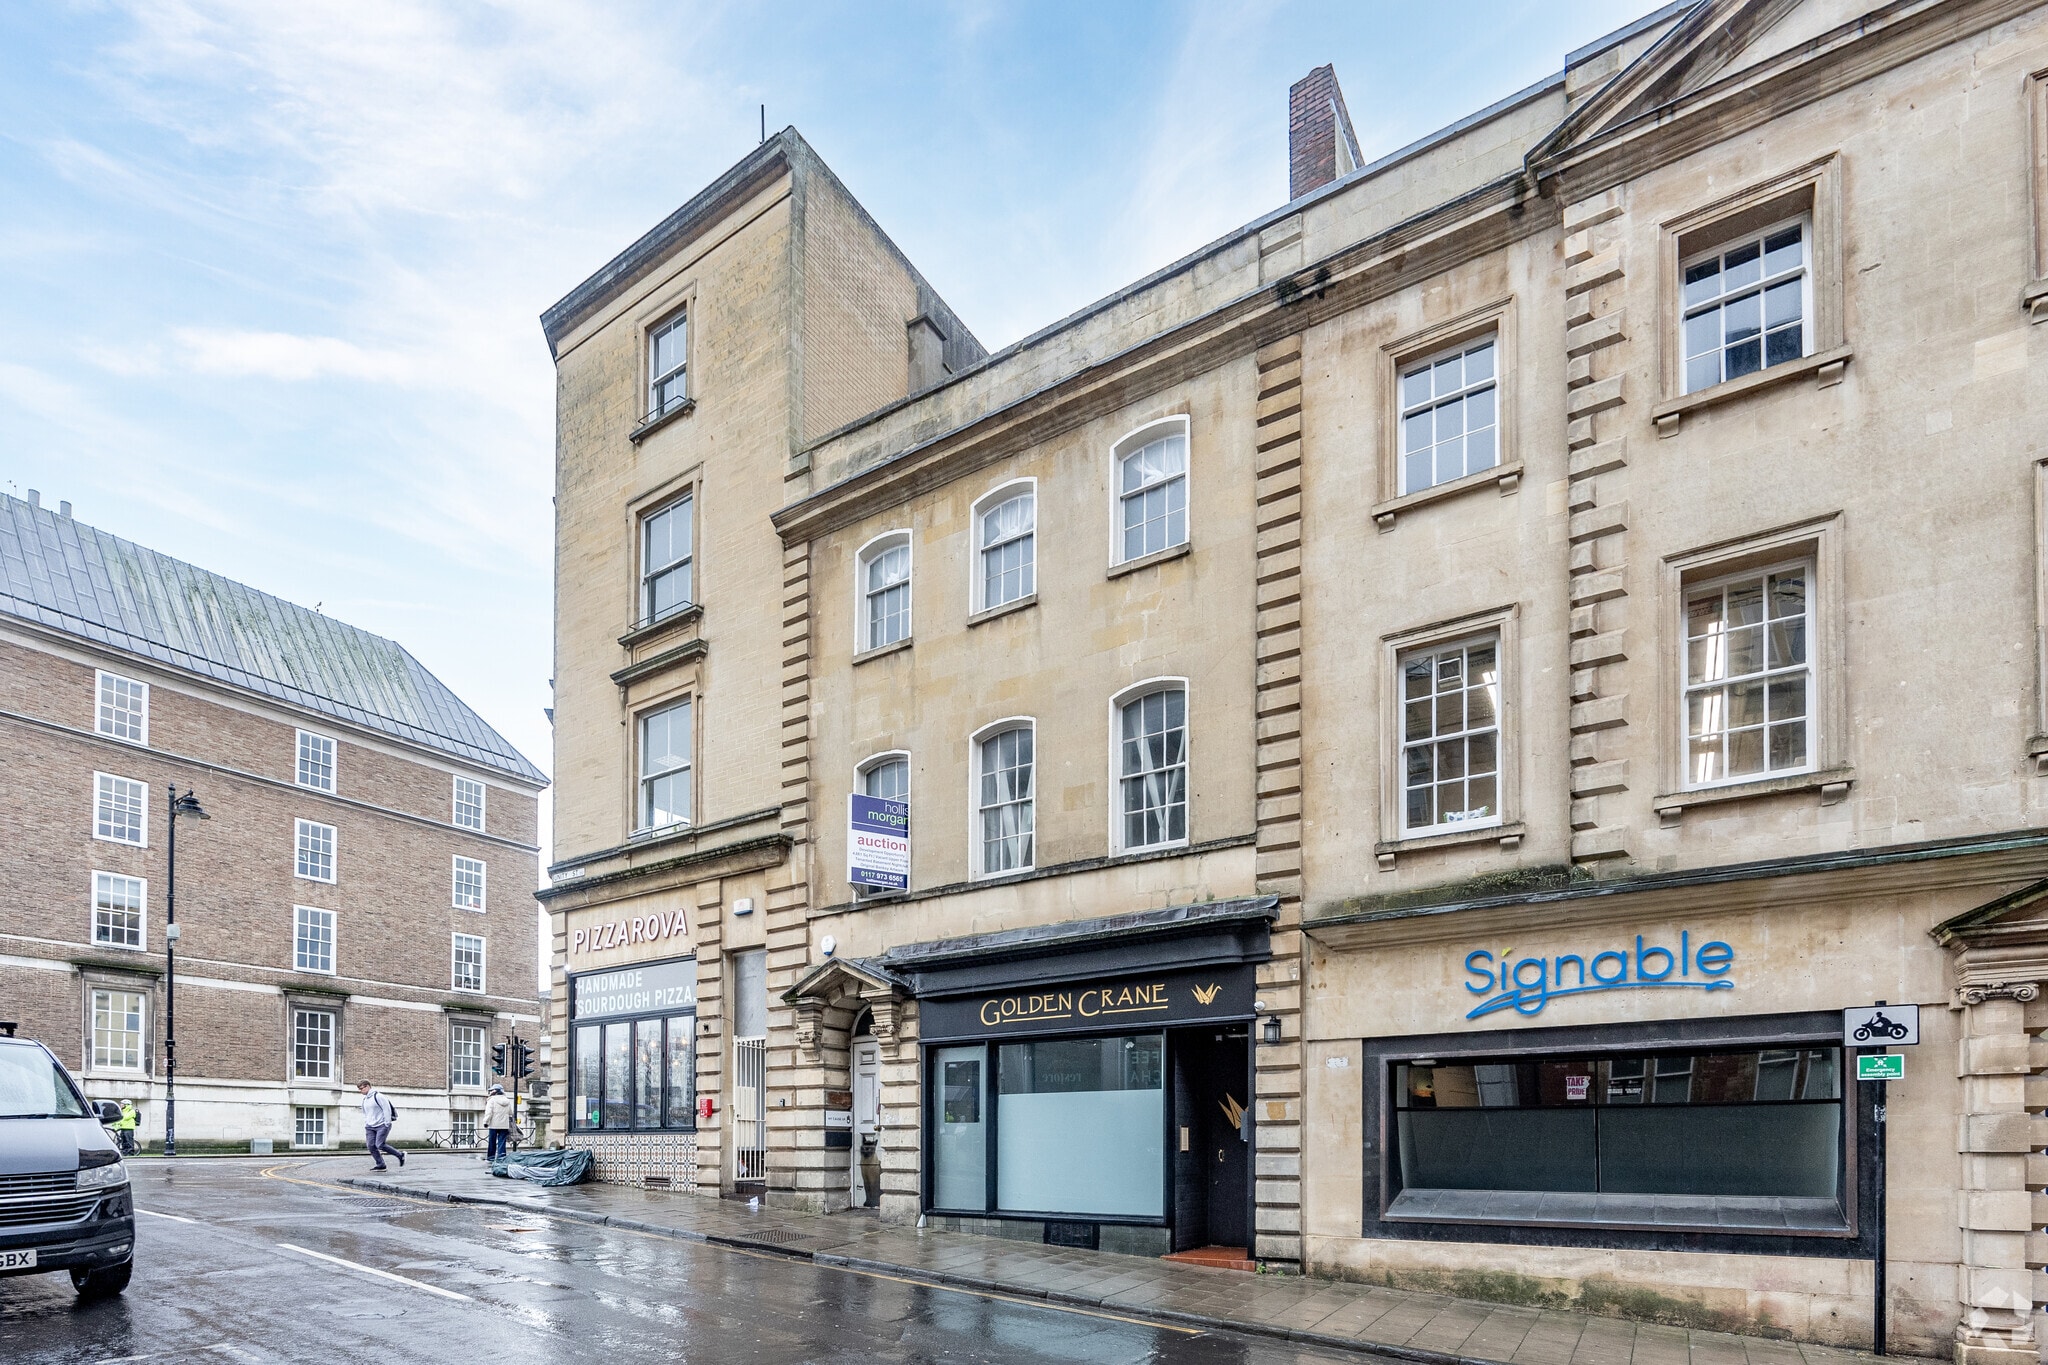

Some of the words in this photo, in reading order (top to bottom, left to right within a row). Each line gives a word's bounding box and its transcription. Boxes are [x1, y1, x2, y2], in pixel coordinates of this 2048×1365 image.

[857, 836, 907, 852] auction
[860, 870, 875, 878] 0117
[876, 872, 888, 880] 973
[573, 908, 688, 954] PIZZAROVA
[576, 971, 642, 995] HANDMADE
[1464, 930, 1734, 1016] Signable
[576, 991, 650, 1016] SOURDOUGH
[980, 992, 1072, 1026] GOLDEN
[1078, 983, 1169, 1017] CRANE
[1566, 1077, 1585, 1087] TAKE
[1567, 1088, 1586, 1096] PRIDE
